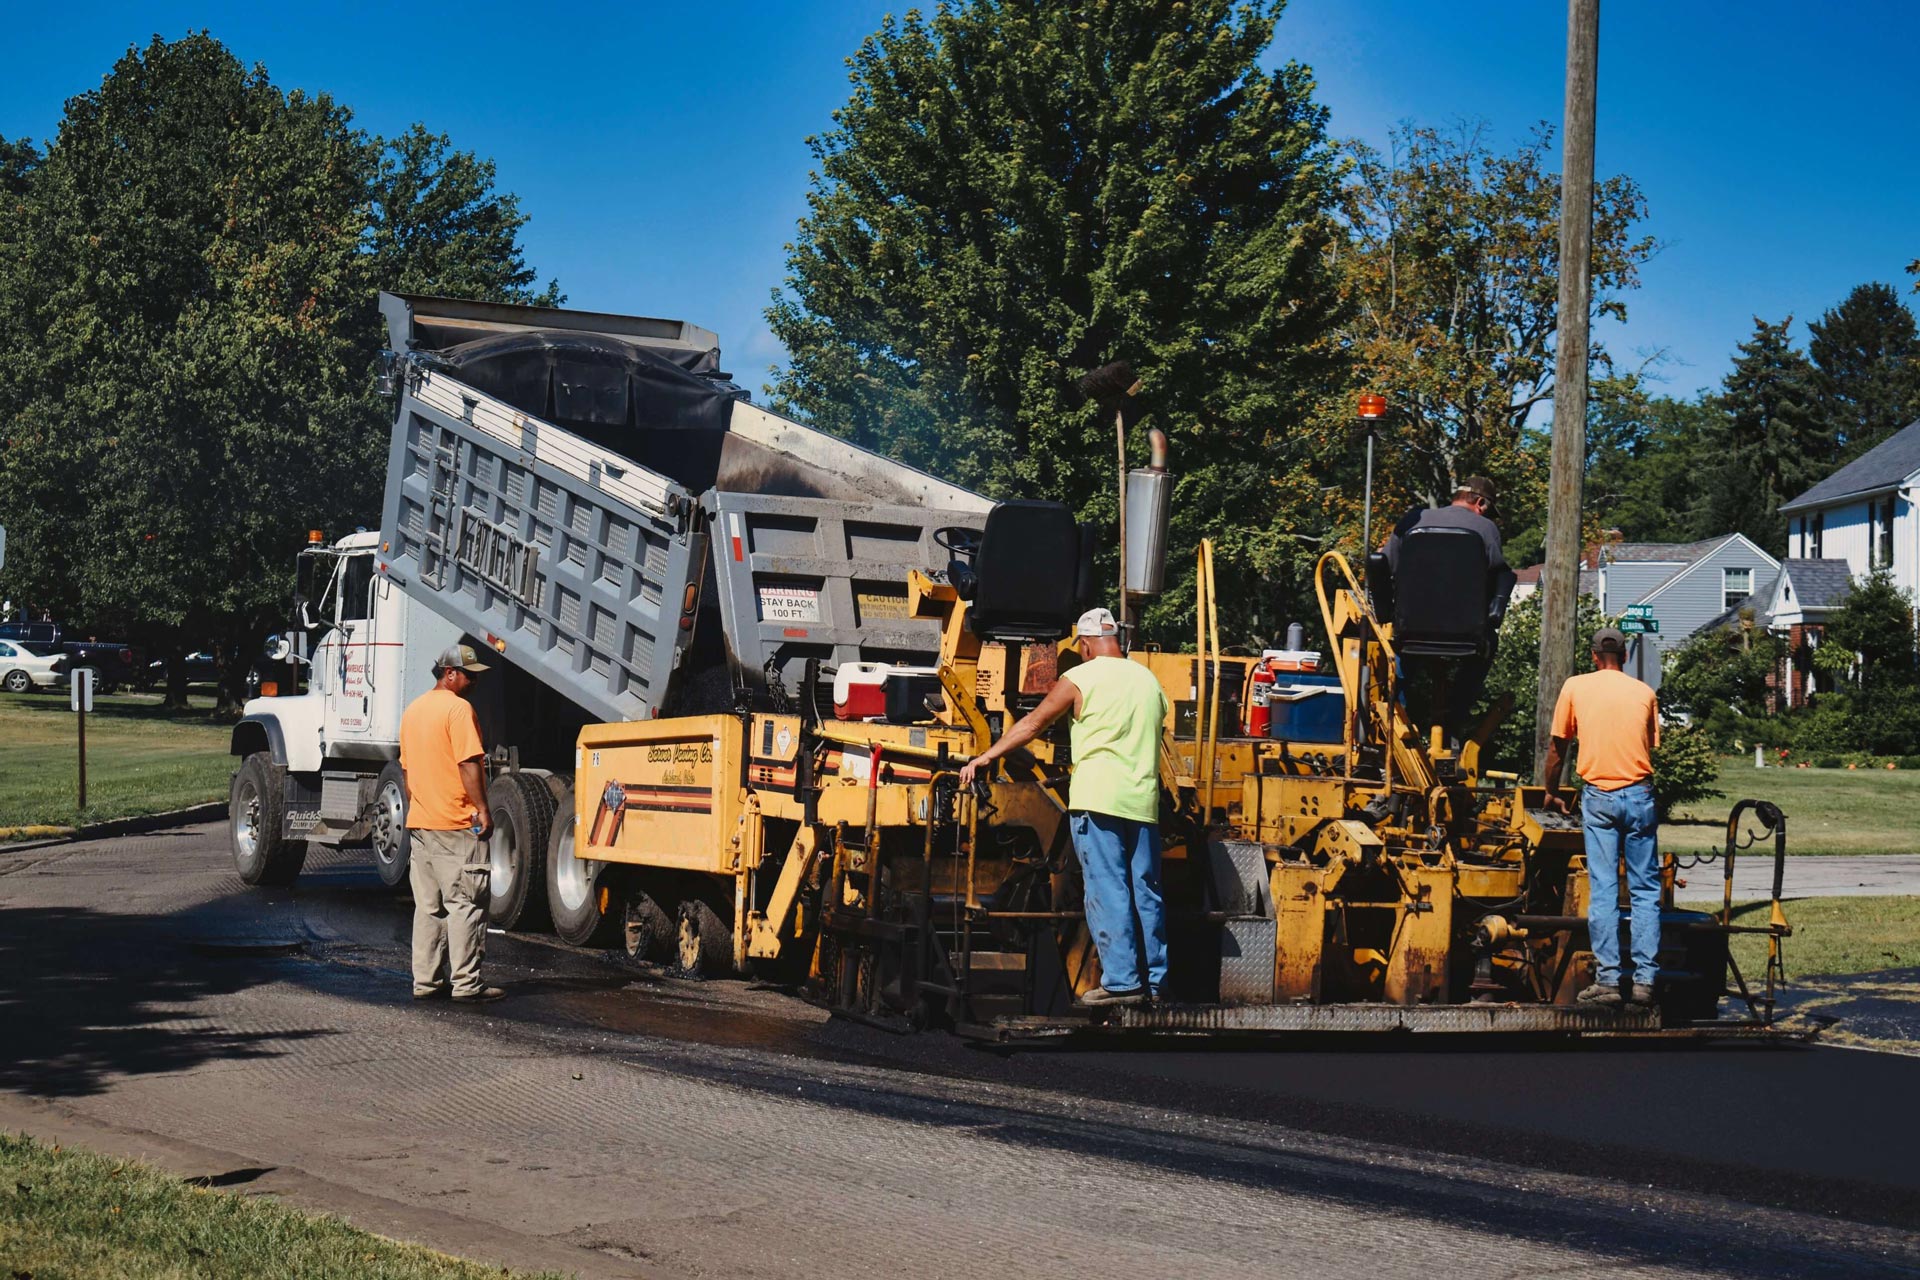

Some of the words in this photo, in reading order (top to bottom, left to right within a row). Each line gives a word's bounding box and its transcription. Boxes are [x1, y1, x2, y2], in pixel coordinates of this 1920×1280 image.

[760, 597, 784, 607] STAY
[787, 599, 815, 609] BACK
[773, 609, 788, 618] 100
[791, 610, 805, 619] FT.
[1627, 607, 1644, 616] BROAD
[1645, 607, 1652, 616] ST
[286, 810, 321, 820] QuickS
